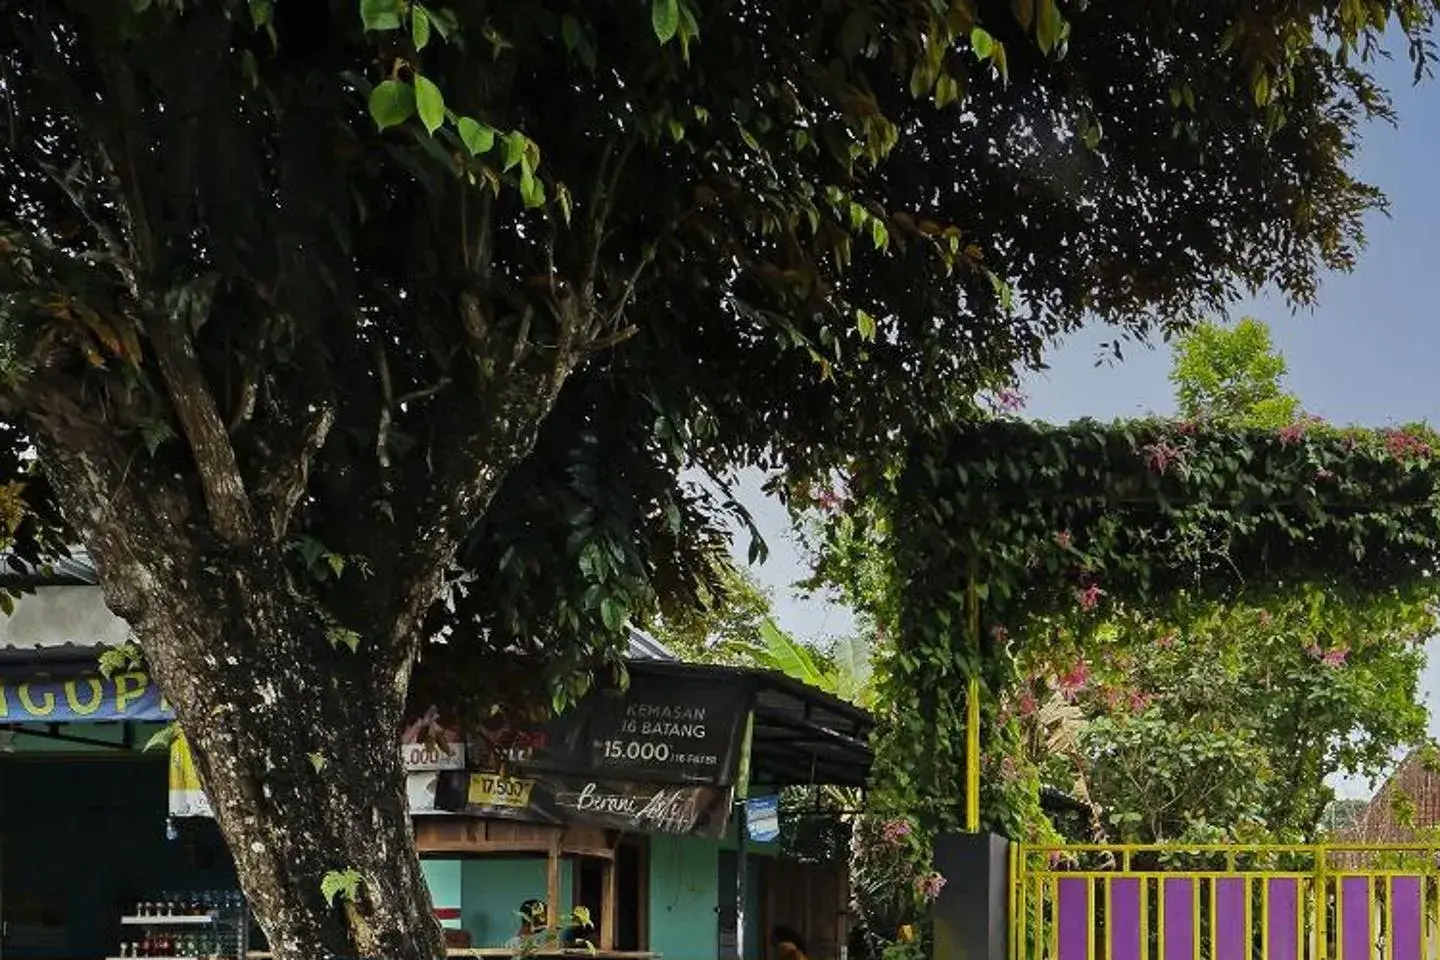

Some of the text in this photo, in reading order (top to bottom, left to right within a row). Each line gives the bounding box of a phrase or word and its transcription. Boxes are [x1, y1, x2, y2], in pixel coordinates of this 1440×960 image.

[626, 704, 706, 721] KEMASAN
[641, 721, 706, 739] BATANG
[603, 739, 670, 762] 15.000
[577, 782, 638, 813] Berani
